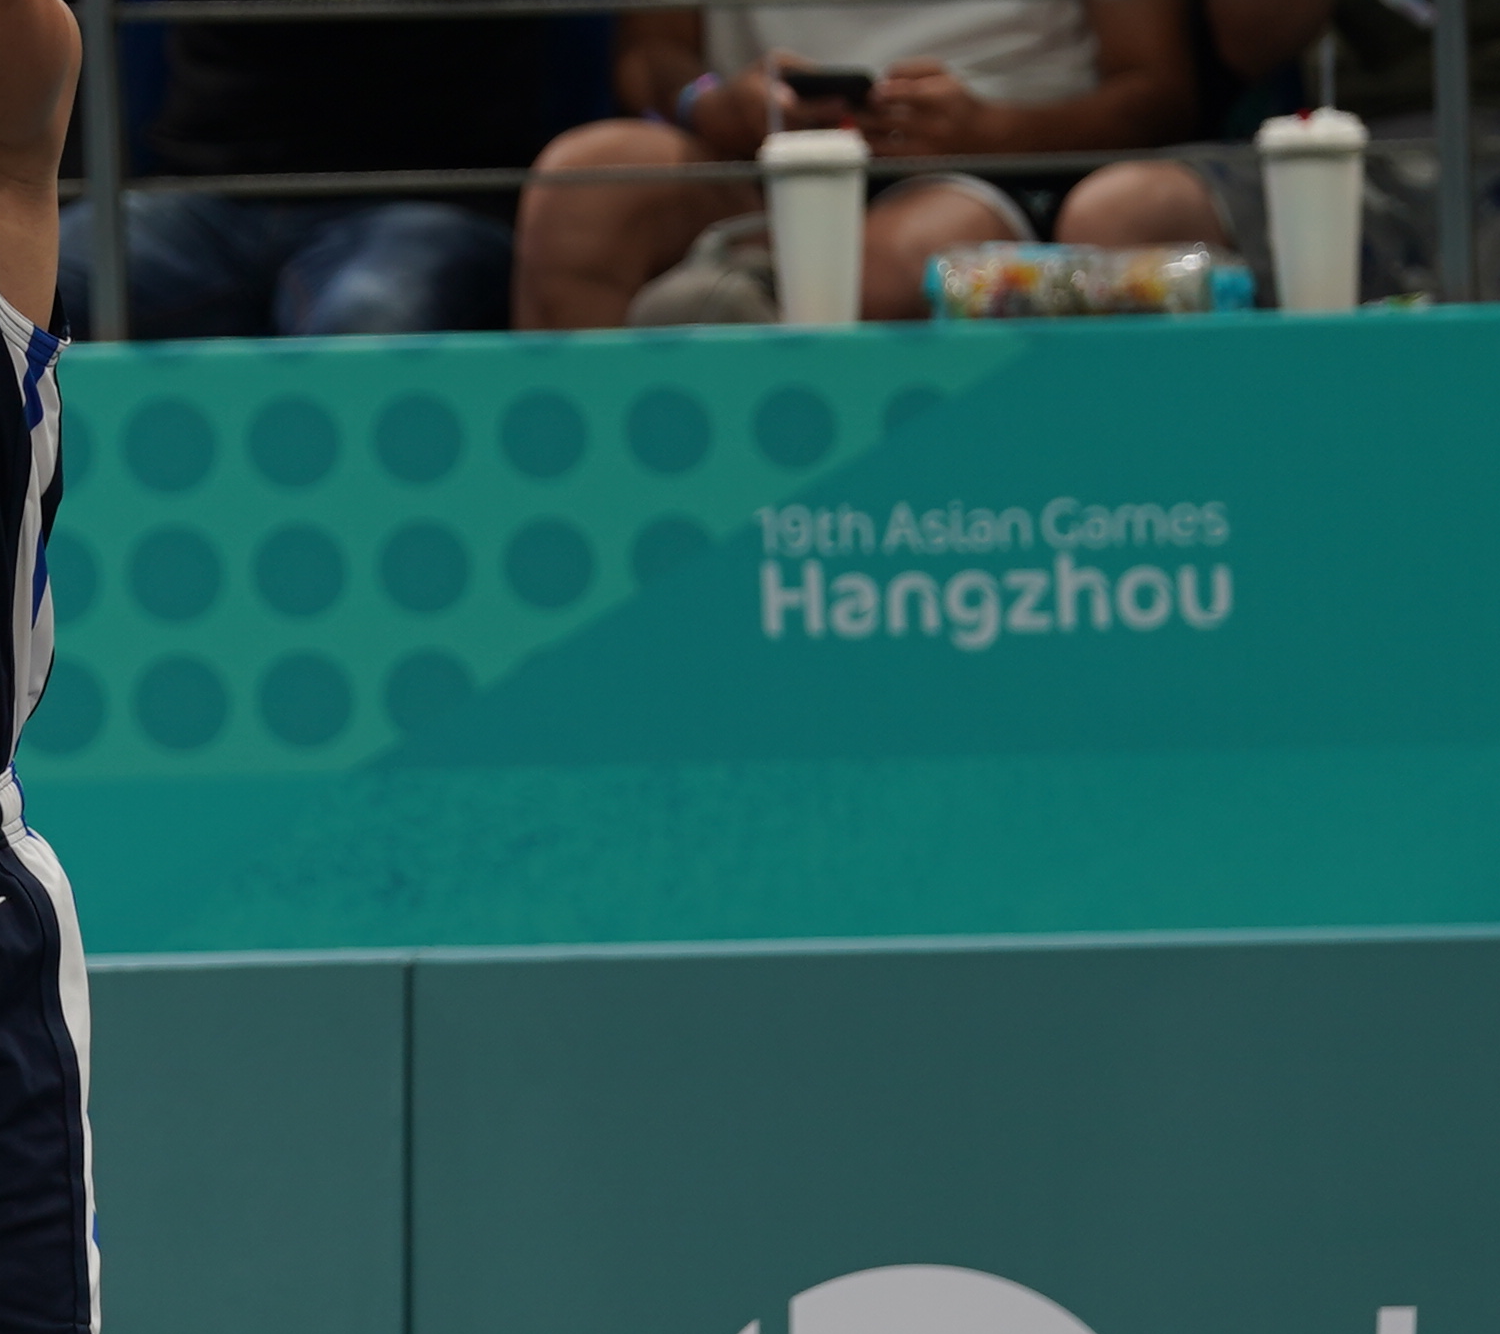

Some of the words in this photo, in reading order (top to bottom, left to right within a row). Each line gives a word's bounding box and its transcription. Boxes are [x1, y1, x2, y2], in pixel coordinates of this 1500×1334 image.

[754, 503, 877, 558] 19th
[882, 499, 1035, 555] Asian
[1040, 496, 1231, 550] Games
[760, 552, 1238, 653] Hangzhou
